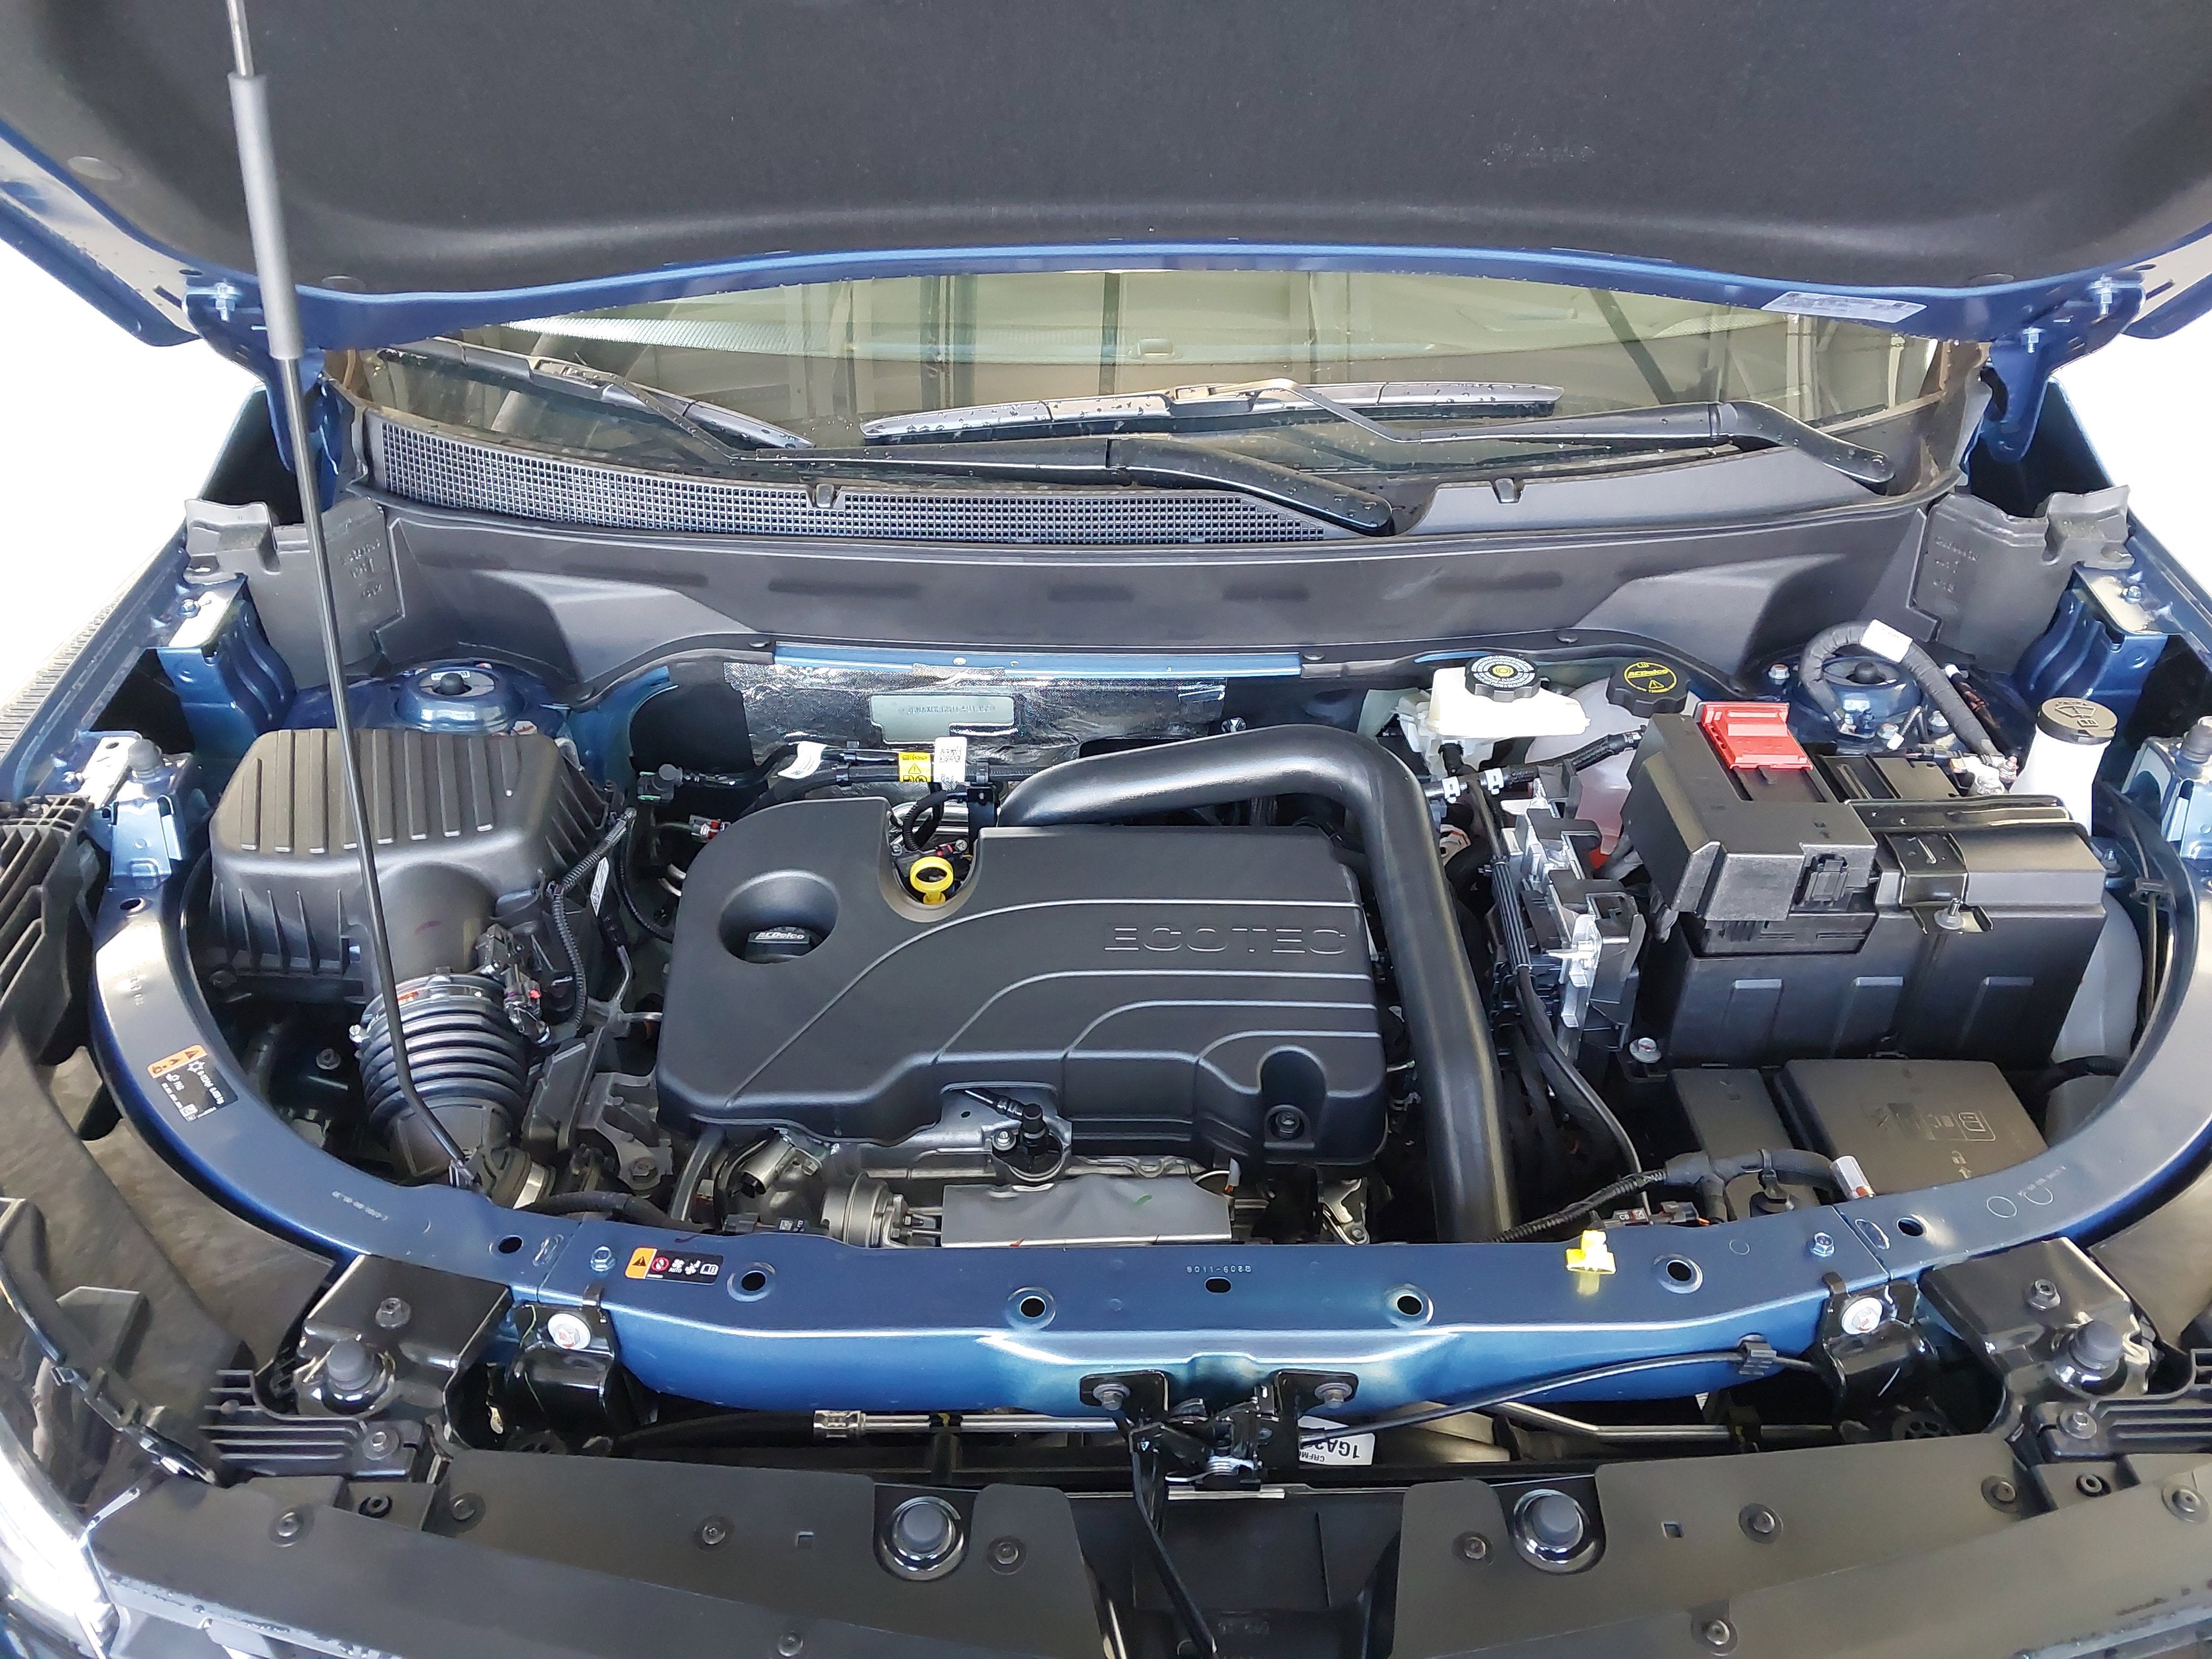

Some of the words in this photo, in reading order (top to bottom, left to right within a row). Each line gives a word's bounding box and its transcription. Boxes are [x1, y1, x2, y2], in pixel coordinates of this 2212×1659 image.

[1628, 669, 1669, 678] ACDelco
[754, 931, 805, 940] ACDelco
[1104, 927, 1347, 955] ECOTEC
[1299, 1451, 1325, 1462] CRFM
